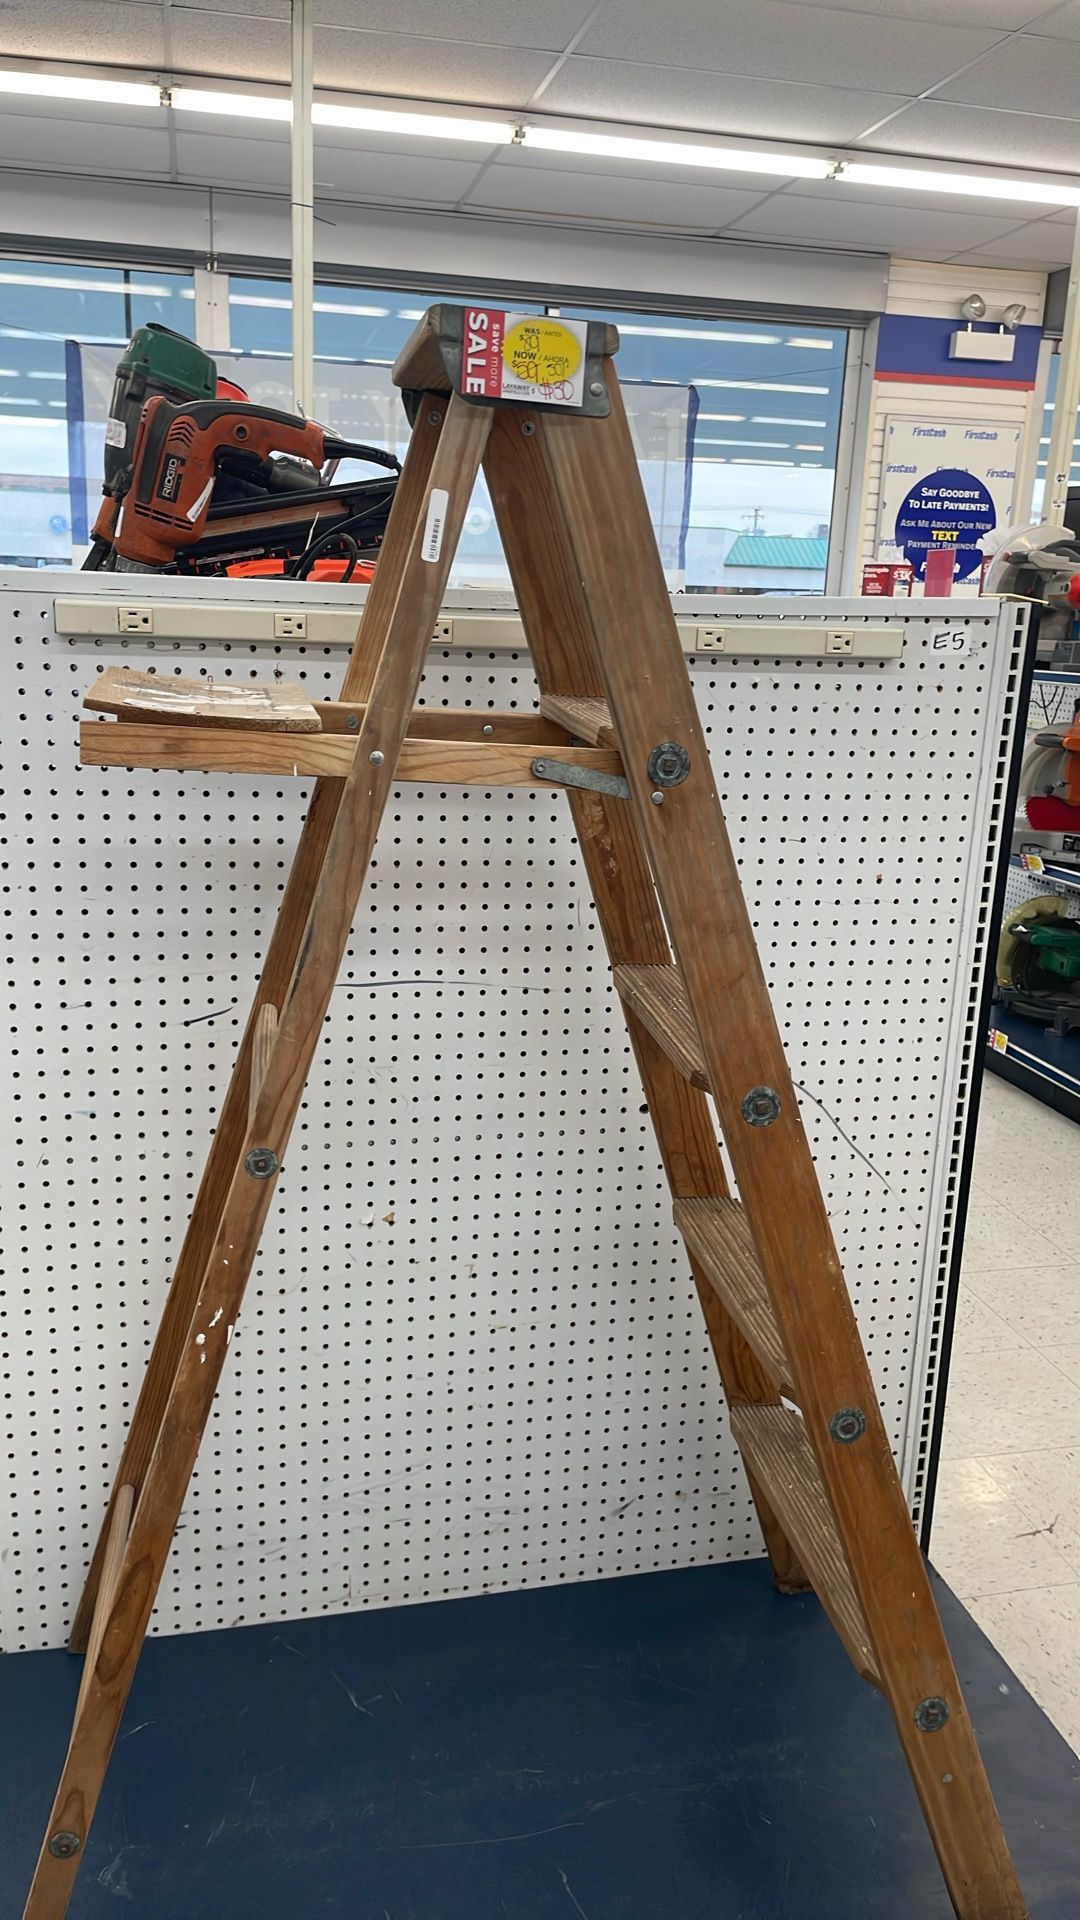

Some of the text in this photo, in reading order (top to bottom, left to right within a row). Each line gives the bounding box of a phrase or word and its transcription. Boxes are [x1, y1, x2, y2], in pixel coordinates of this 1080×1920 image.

[524, 327, 540, 335] WAS
[466, 311, 489, 394] SALE
[489, 323, 500, 387] save more
[513, 350, 537, 360] NOW
[503, 383, 530, 391] LAYAWAY
[912, 426, 946, 438] FirstCash
[964, 430, 998, 440] FirstCash
[886, 464, 917, 474] irstCash
[162, 458, 178, 497] RIDGID
[921, 487, 980, 499] SAY GOODBYE
[908, 499, 990, 512] TO LATE PAYMENTS!
[900, 519, 993, 530] ASK ME ABOUT OUR NEW
[931, 530, 960, 541] TEXT
[907, 540, 977, 550] PAYMENT REMINDE
[933, 631, 965, 651] E5
